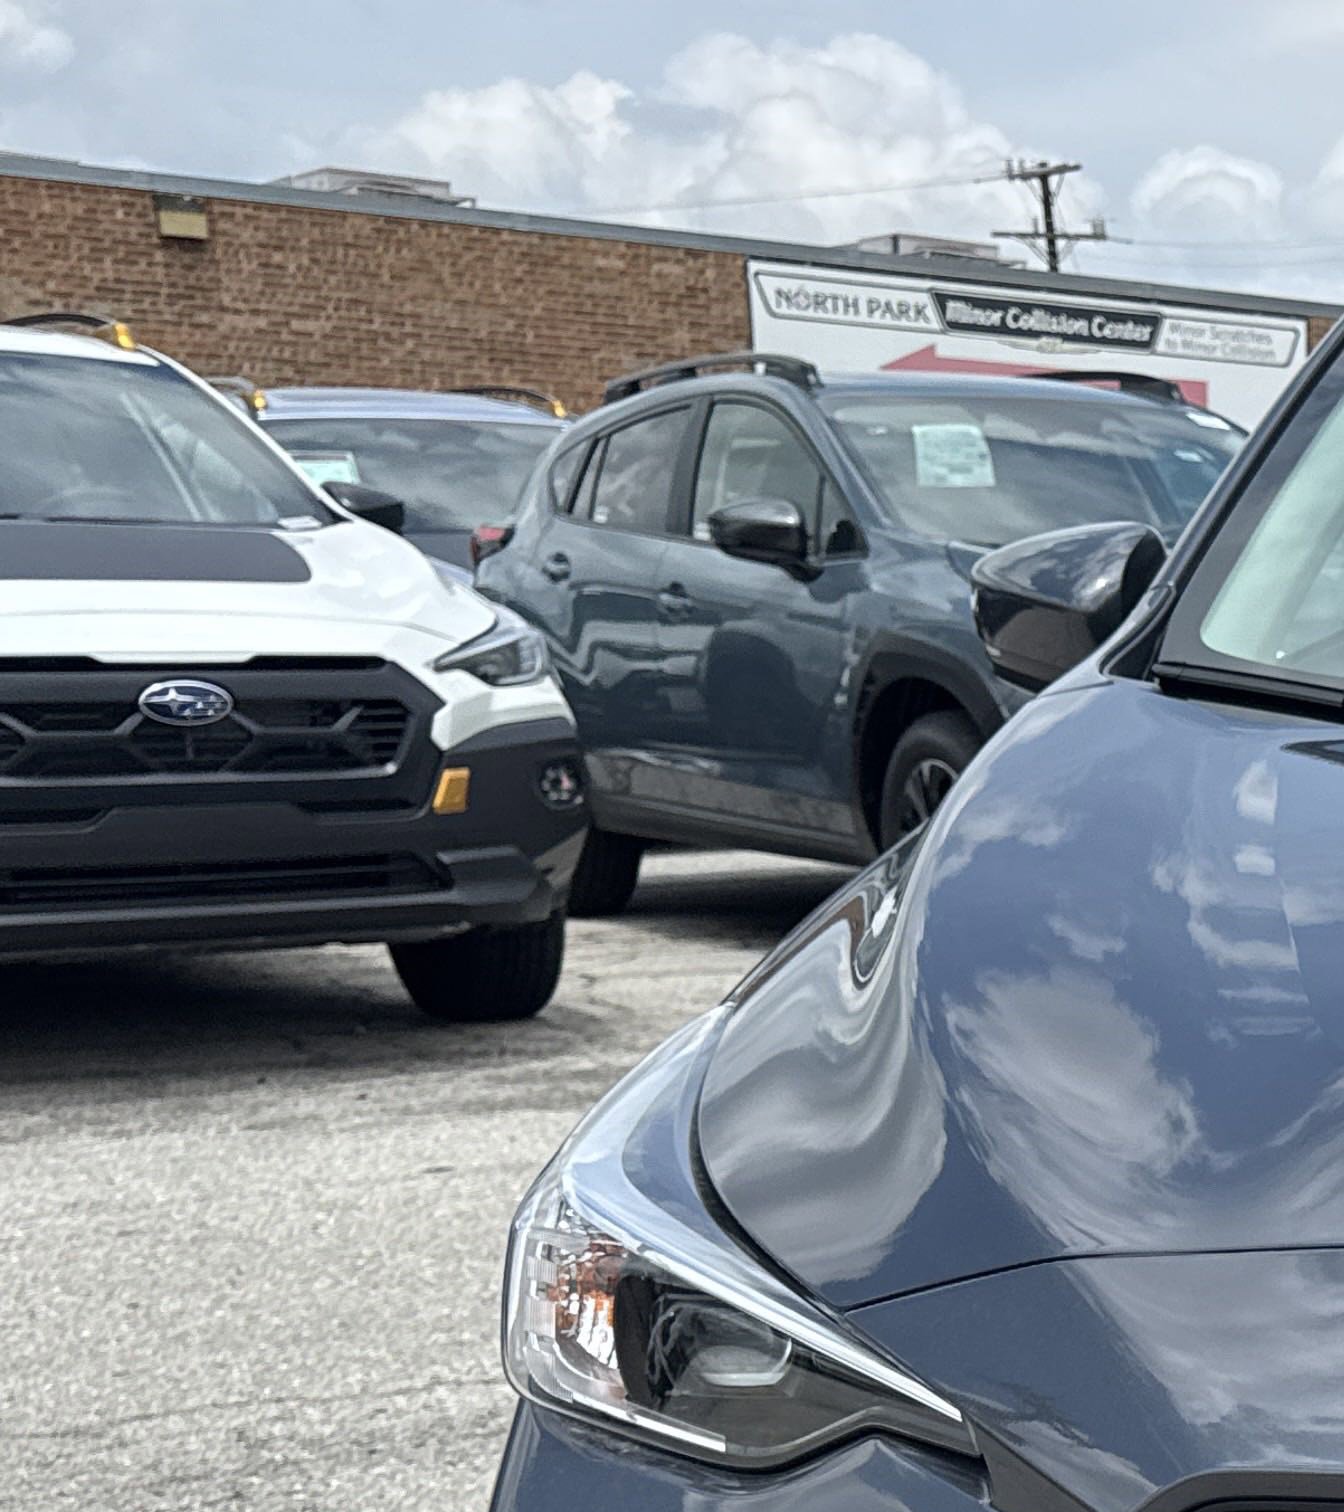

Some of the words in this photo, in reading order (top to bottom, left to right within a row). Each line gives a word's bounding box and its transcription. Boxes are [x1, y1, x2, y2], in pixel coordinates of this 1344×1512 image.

[774, 286, 860, 317] NORTH
[866, 297, 931, 325] PARK
[1005, 306, 1090, 337] Collision
[1090, 315, 1154, 342] Center
